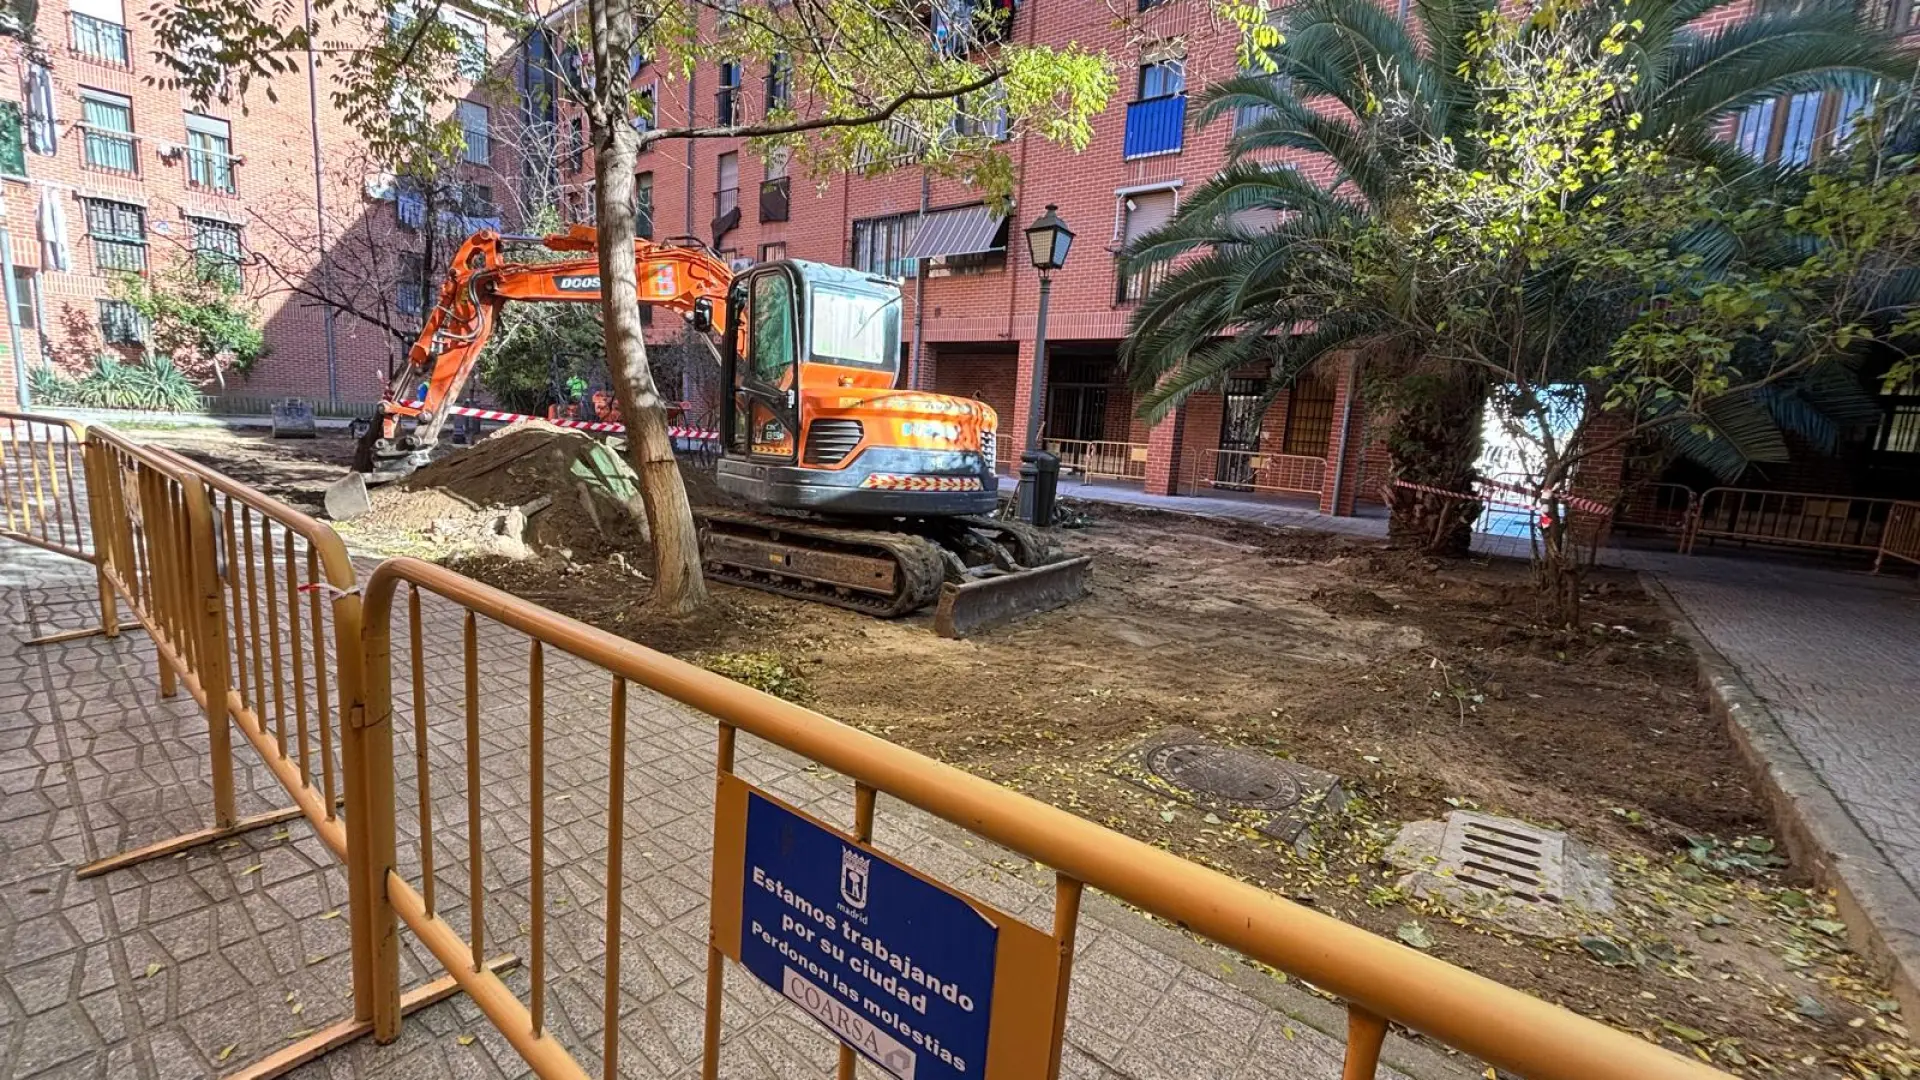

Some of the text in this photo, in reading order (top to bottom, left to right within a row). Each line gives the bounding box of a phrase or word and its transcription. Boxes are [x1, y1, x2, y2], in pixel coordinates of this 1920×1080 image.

[753, 866, 974, 1012] Estamos trabajando
[837, 902, 868, 925] madrid
[752, 921, 966, 1072] Perdonen las molestias
[782, 914, 926, 1015] por su ciudad
[791, 977, 880, 1056] COARSA
